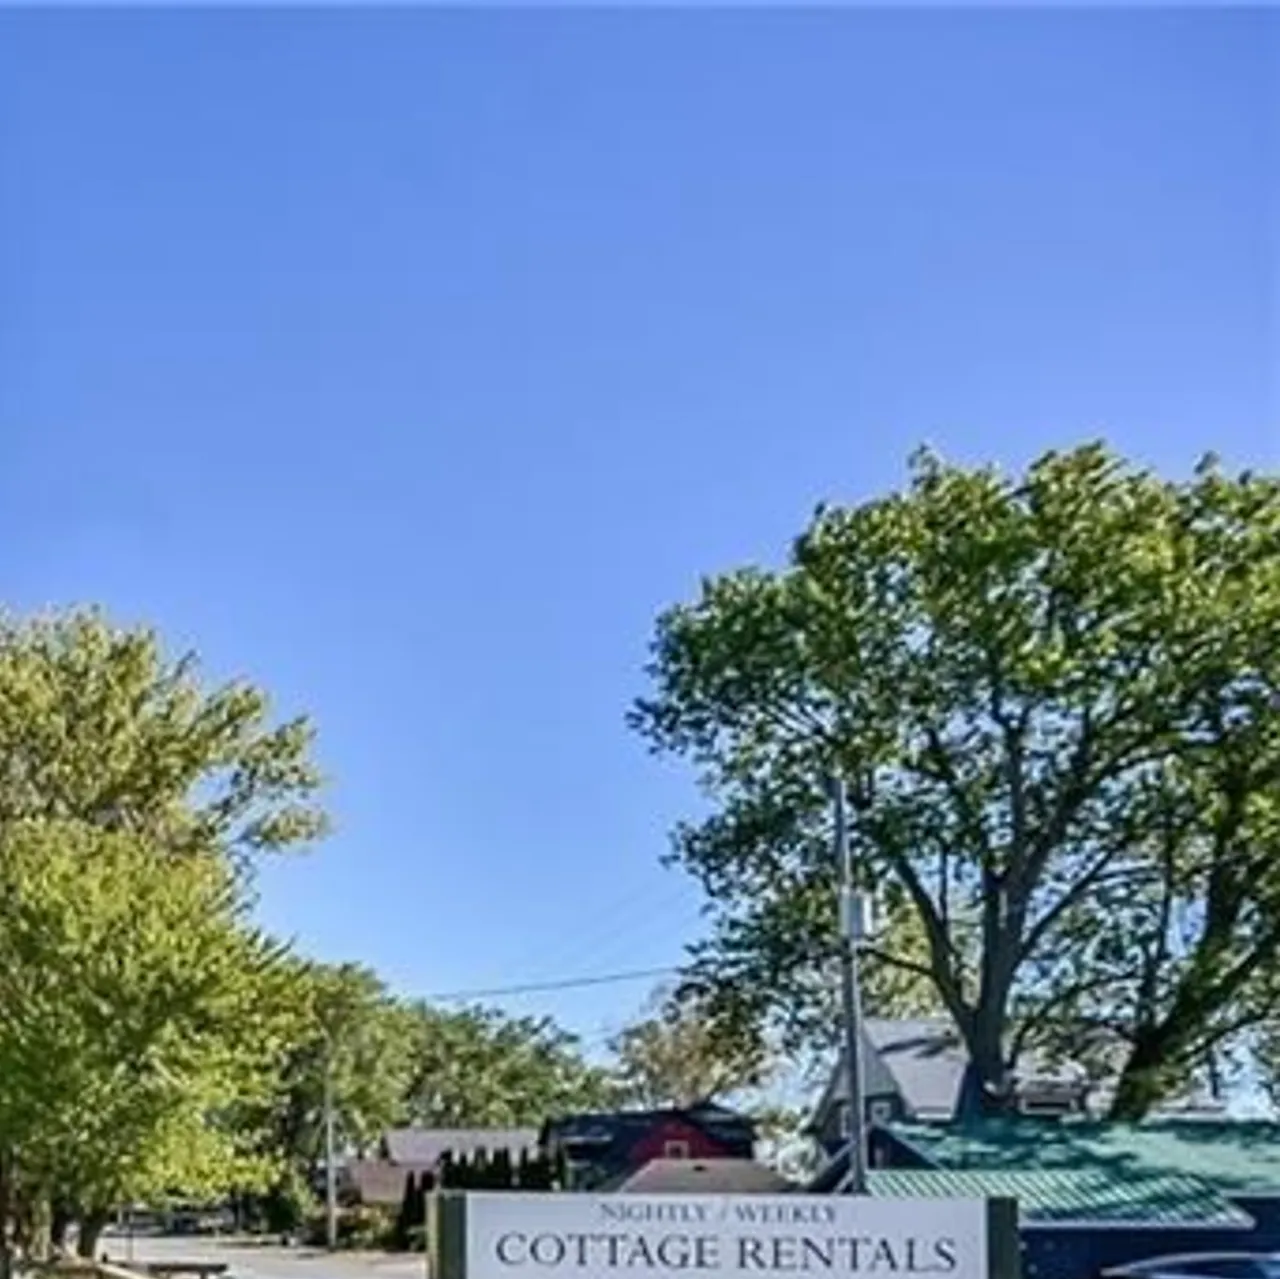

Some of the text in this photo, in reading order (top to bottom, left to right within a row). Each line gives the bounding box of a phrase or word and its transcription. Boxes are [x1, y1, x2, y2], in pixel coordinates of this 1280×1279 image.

[599, 1203, 707, 1222] NIGHTLY
[736, 1204, 838, 1224] WEEKLY
[495, 1233, 958, 1273] COTTAGE RENTALS
